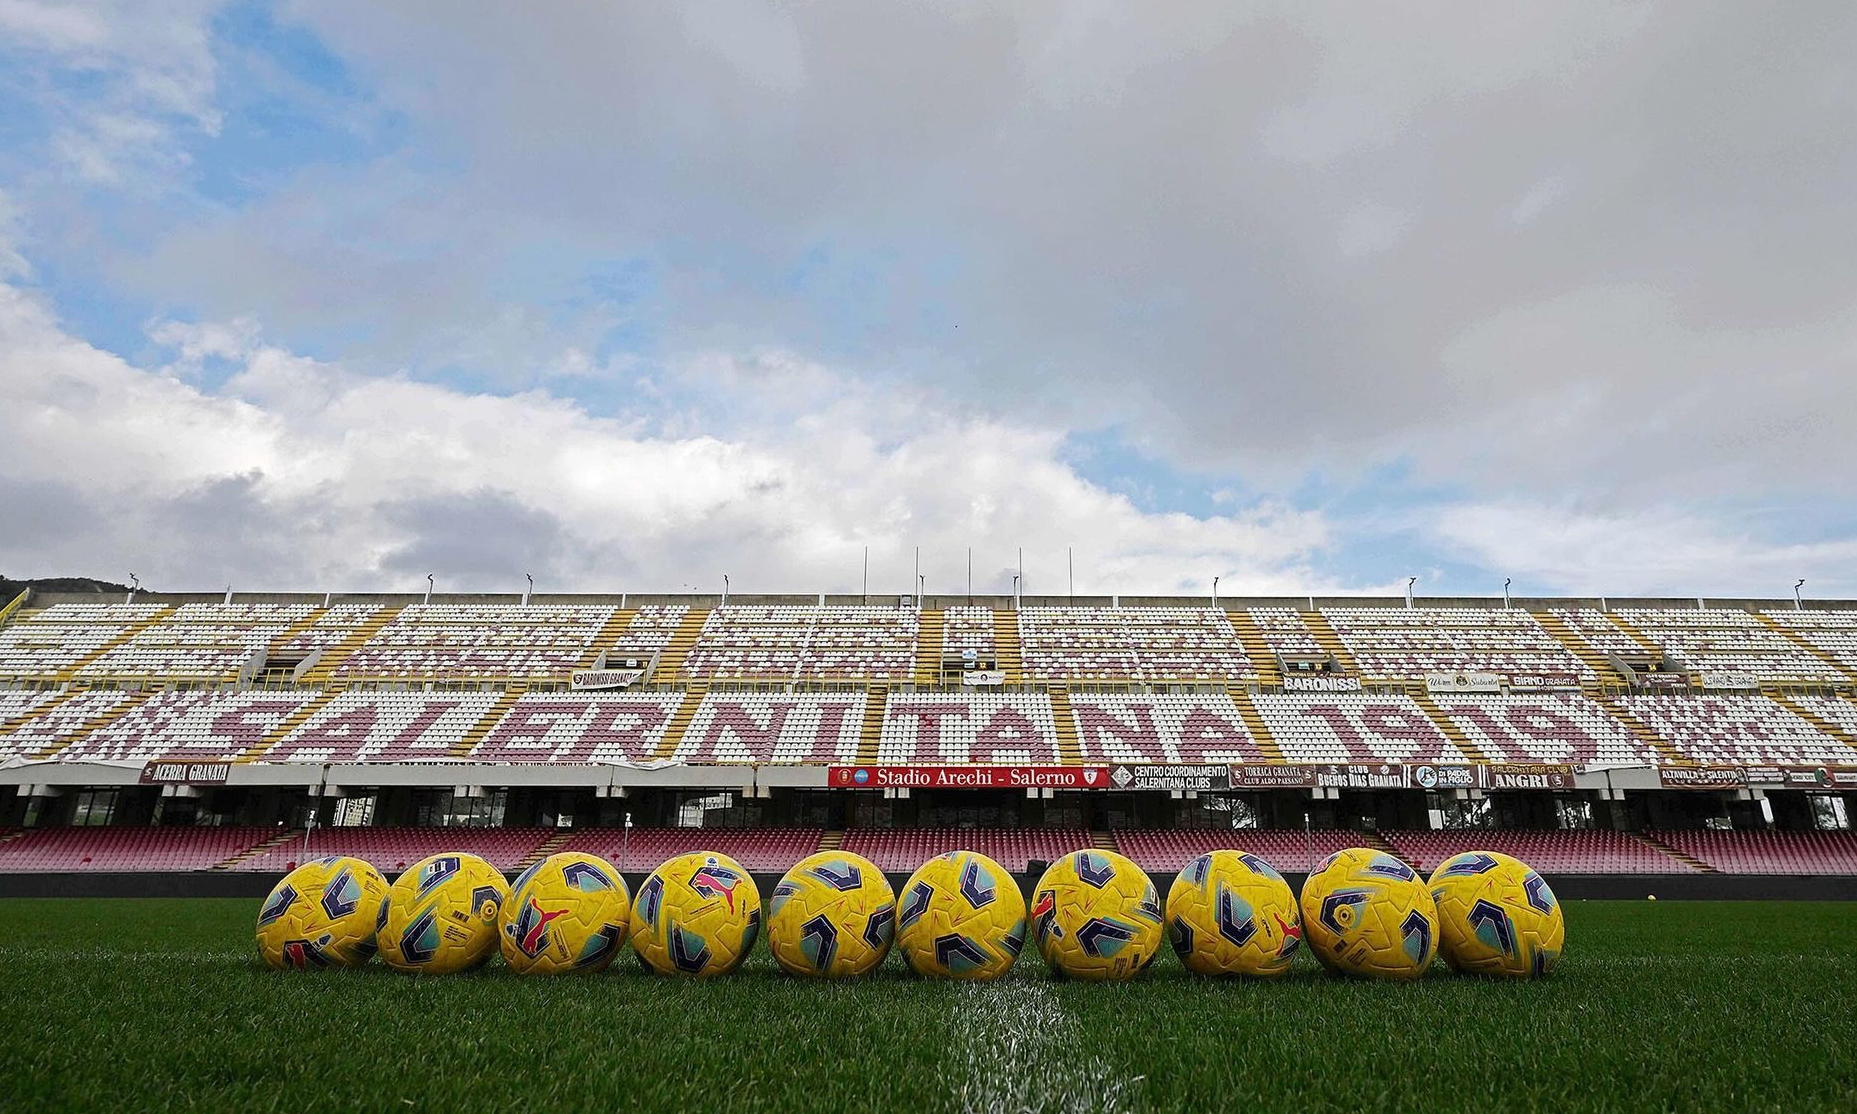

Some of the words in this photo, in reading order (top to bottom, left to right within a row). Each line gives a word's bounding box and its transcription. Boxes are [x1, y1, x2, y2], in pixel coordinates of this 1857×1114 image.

[1283, 677, 1362, 691] BARONISSI
[1545, 678, 1576, 686] GRANATA
[152, 764, 188, 781] ACERRA
[188, 764, 229, 781] GRANATA
[1134, 766, 1164, 777] CENTRO
[1164, 766, 1227, 777] COORDINAMENTO
[1244, 767, 1270, 777] TORRACA
[1272, 766, 1301, 777] GRANATA
[1348, 766, 1369, 774] CLUB
[1491, 766, 1545, 774] SALERNITANA
[1548, 766, 1568, 774] CLUB
[1662, 769, 1698, 779] ALTAVILLA
[877, 769, 930, 785] Stadio
[936, 769, 992, 785] Arechi
[1010, 769, 1075, 785] Salerno
[1244, 777, 1260, 785] CLUB
[1261, 777, 1276, 785] ALDO
[1318, 773, 1348, 787] BUENOS
[1349, 774, 1368, 787] DIAS
[1368, 774, 1402, 787] GRANATA
[1438, 776, 1447, 784] IN
[1448, 776, 1474, 784] FIGLIO
[1495, 774, 1550, 788] ANGRI
[1134, 777, 1185, 789] SALERNITANA
[1186, 777, 1211, 789] CLUBS
